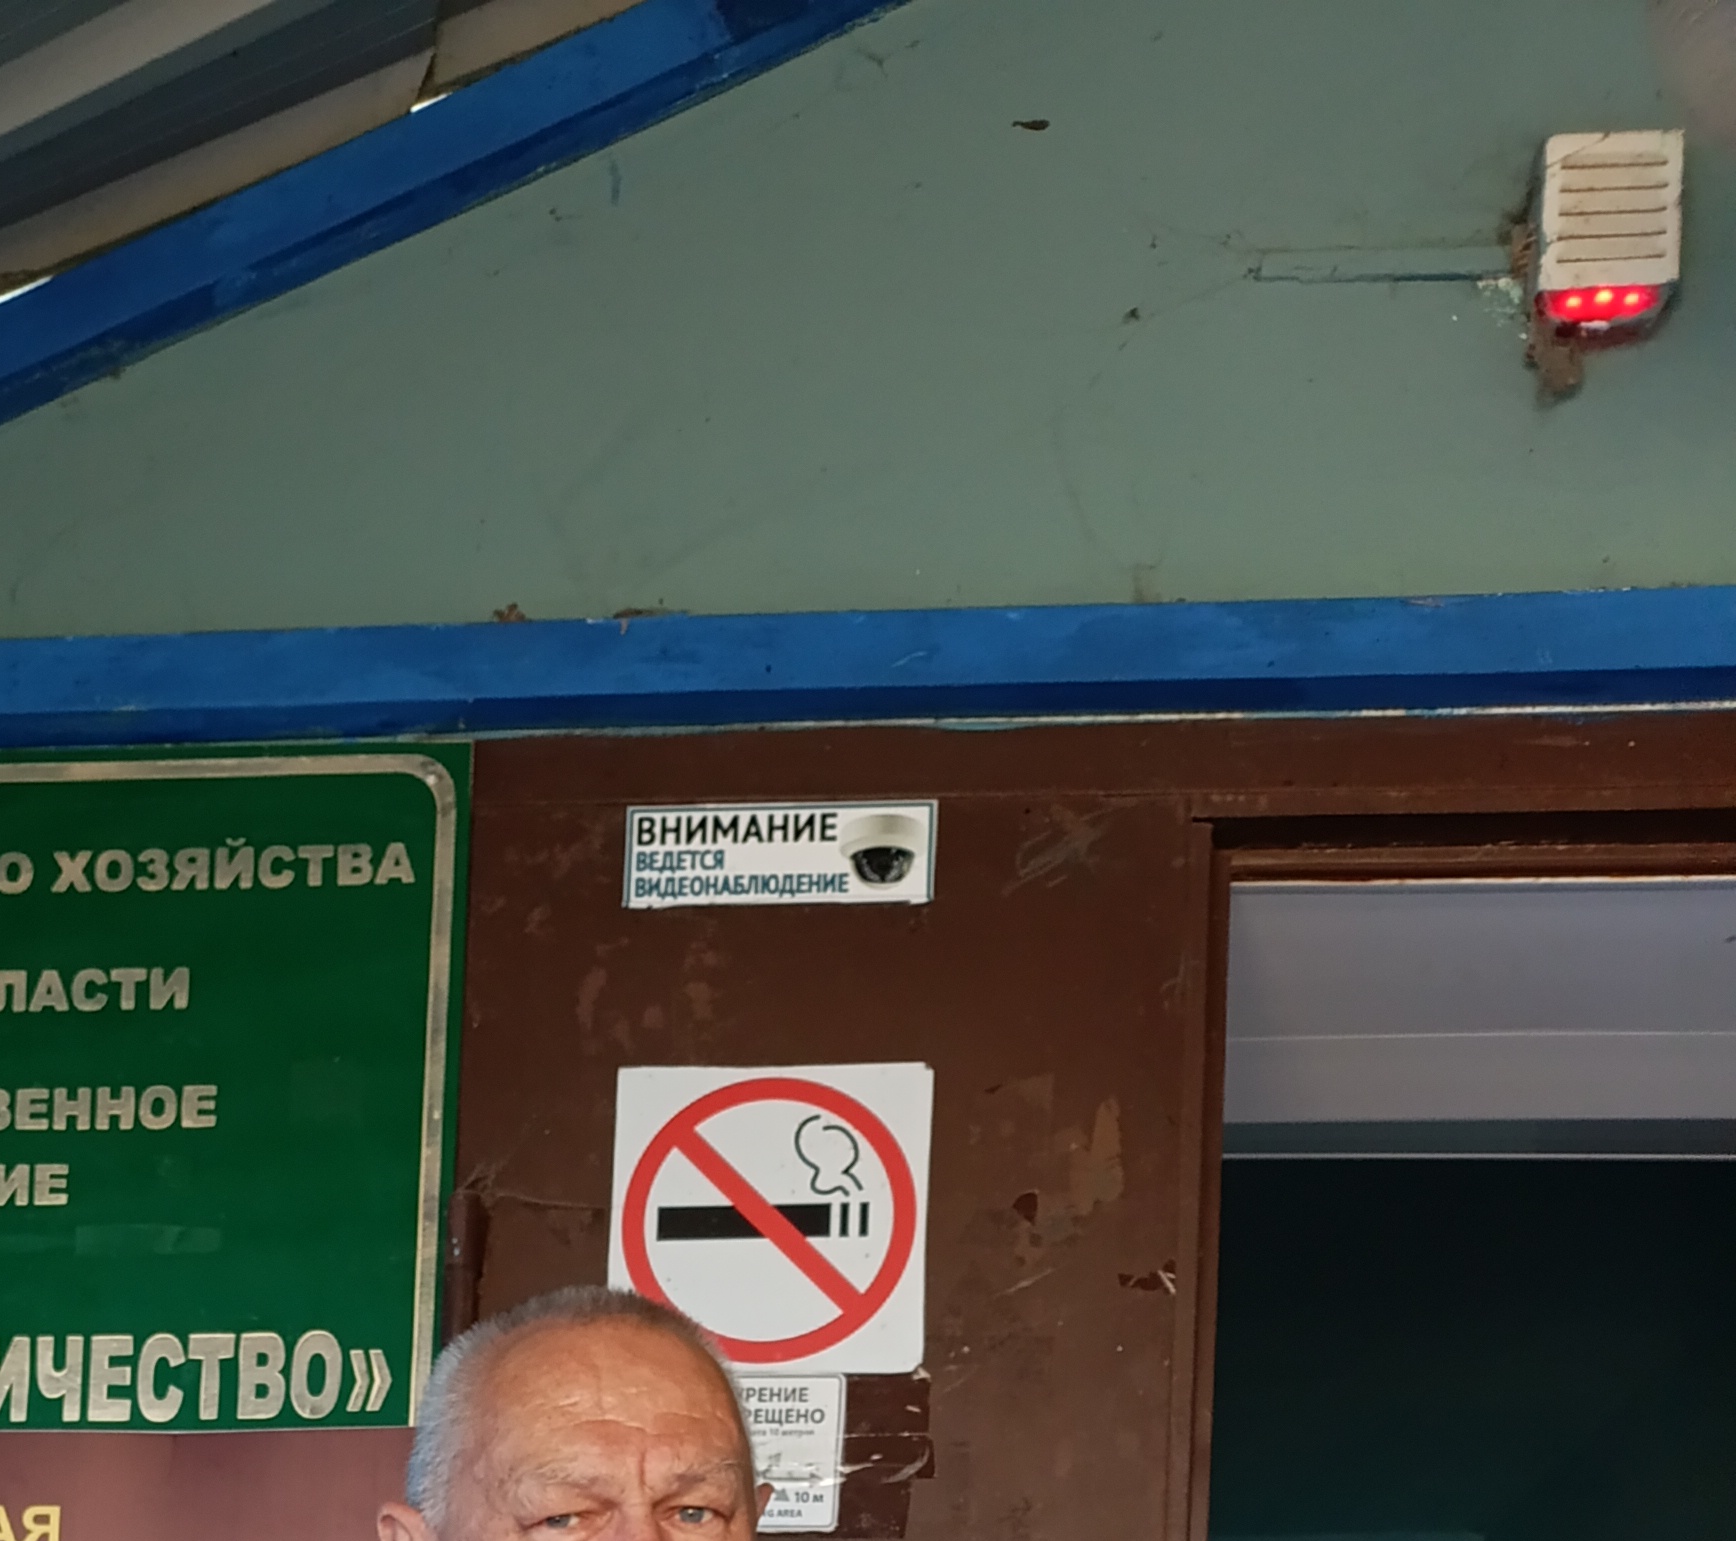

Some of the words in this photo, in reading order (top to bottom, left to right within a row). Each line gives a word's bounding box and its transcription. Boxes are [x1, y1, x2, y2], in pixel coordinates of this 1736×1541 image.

[636, 812, 838, 846] ВНИМАНИЕ
[50, 837, 416, 894] ХОЗЯЙСТВА
[635, 849, 725, 873] ВЕДЕТСЯ
[634, 871, 849, 898] ВИДЕОНАБЛЮДЕНИЕ
[737, 1386, 809, 1403] РЕНИЕ
[795, 1491, 810, 1503] 10
